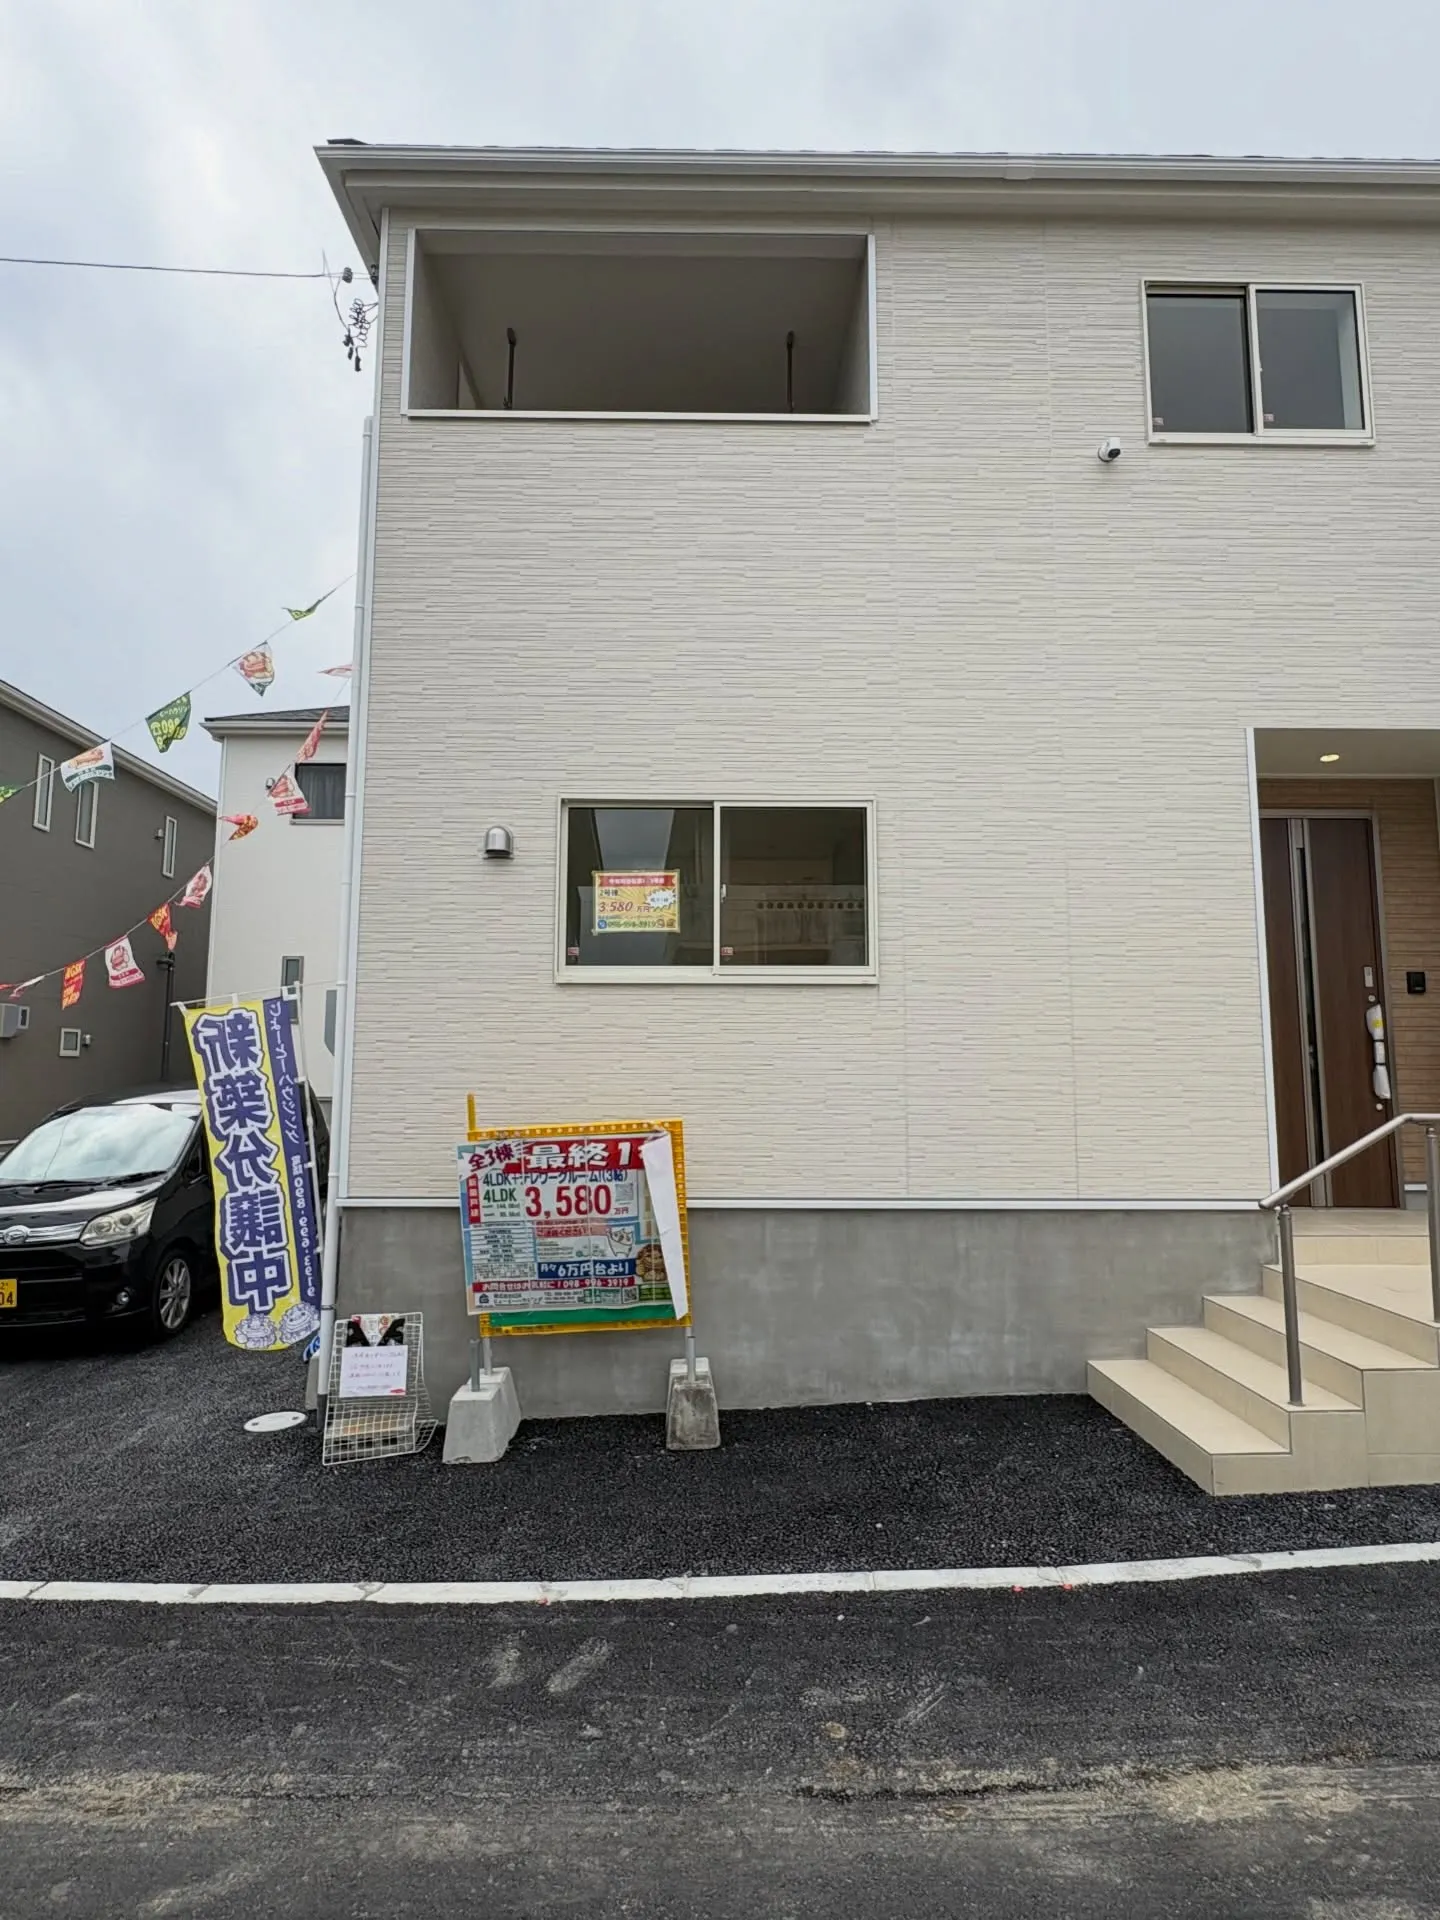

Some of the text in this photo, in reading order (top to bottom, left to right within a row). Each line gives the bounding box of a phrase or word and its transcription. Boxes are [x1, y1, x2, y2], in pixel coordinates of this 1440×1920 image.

[469, 1143, 514, 1172] 全3棟
[526, 1141, 645, 1169] 最終1
[483, 1188, 517, 1203] 4LDK
[525, 1184, 612, 1219] 3,580
